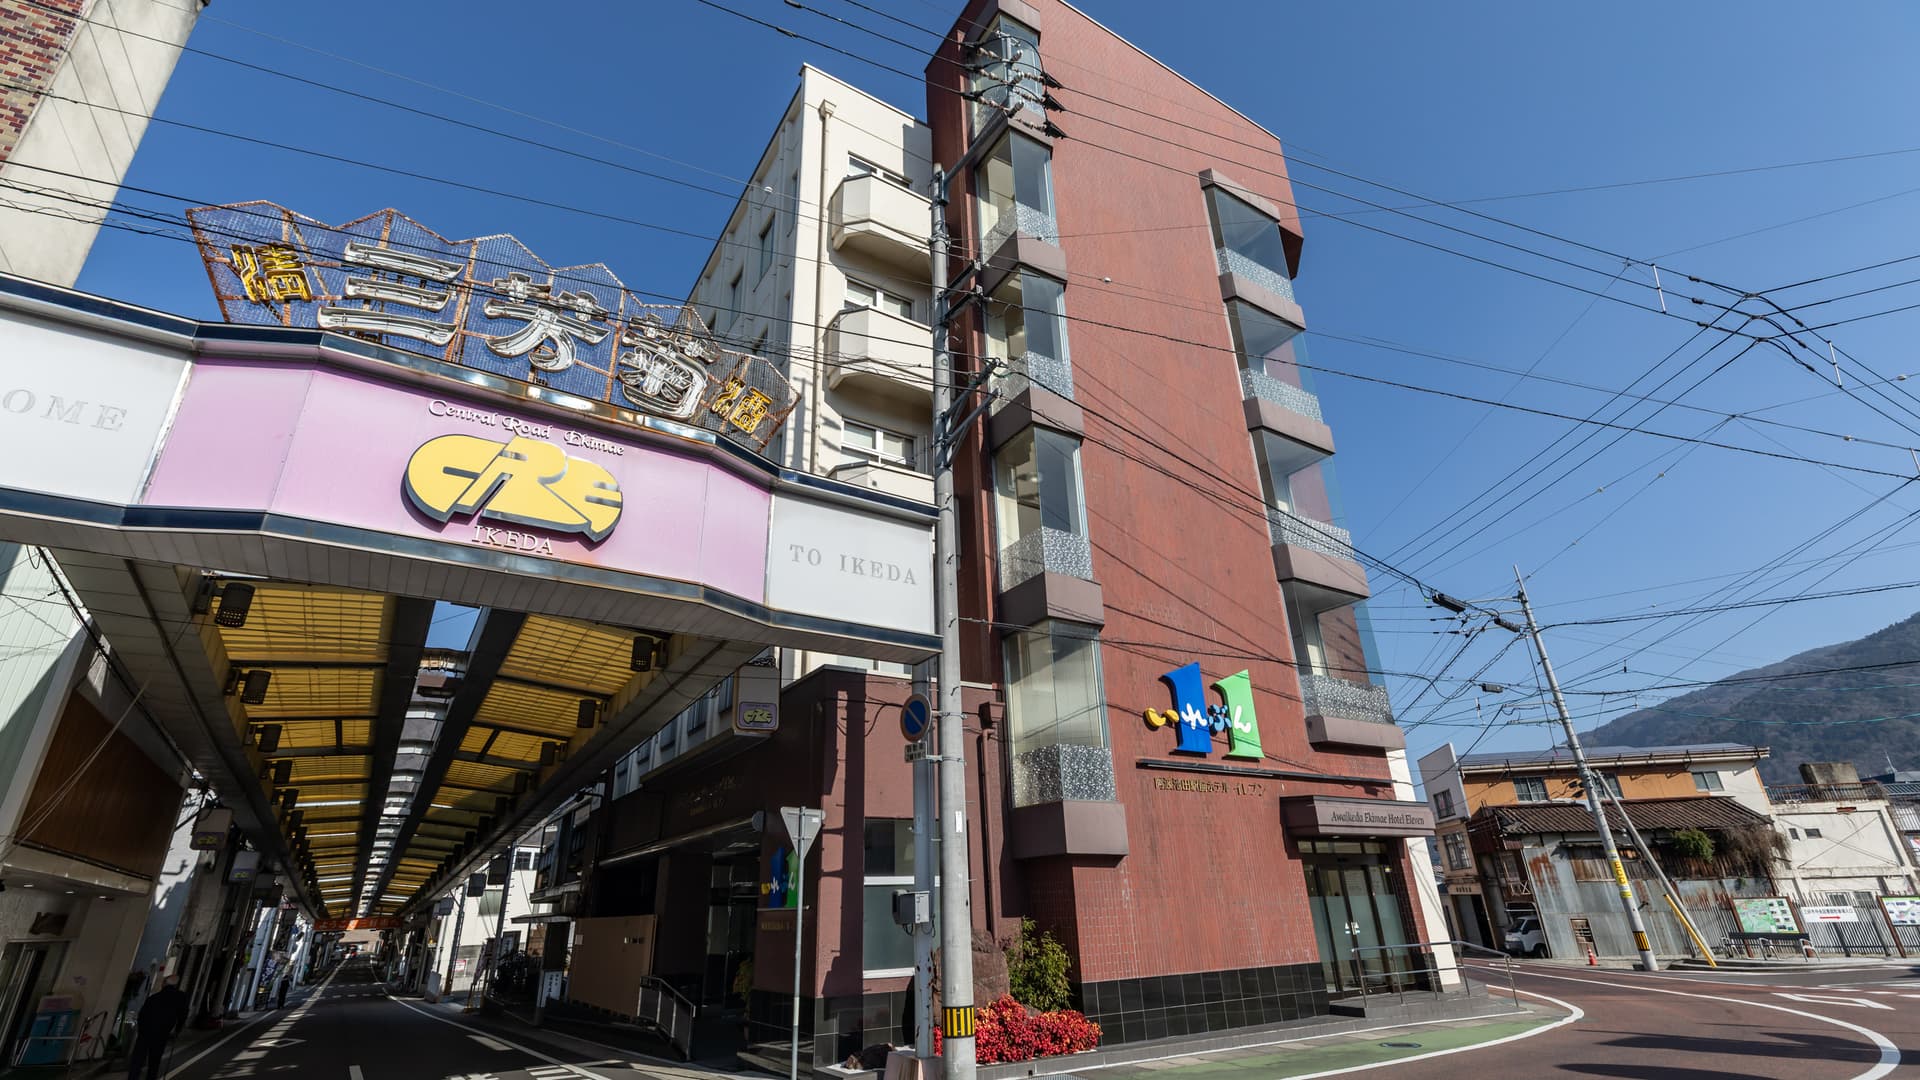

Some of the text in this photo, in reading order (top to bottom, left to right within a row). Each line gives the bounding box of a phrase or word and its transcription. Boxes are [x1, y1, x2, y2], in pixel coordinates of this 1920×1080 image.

[429, 399, 625, 457] Central Road Ekimae
[472, 525, 554, 556] IKEDA
[789, 543, 917, 586] TO IKEDA
[1144, 702, 1252, 733] いれぶん
[1331, 811, 1425, 826] Awaikeda Ekimae Hotel Eleven
